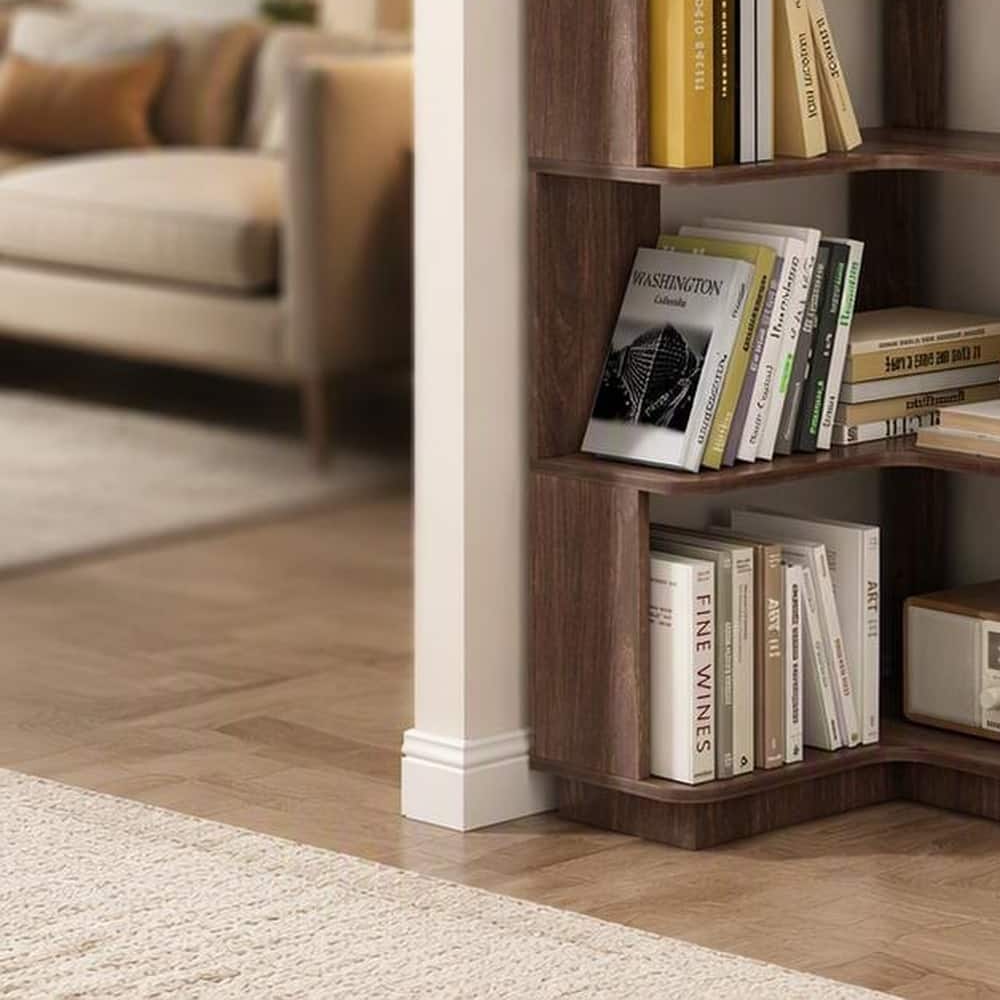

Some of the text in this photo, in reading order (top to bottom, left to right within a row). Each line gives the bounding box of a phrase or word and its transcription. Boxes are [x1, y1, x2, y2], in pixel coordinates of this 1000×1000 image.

[633, 270, 723, 296] WASHINGTON
[695, 594, 712, 754] FINE WINES
